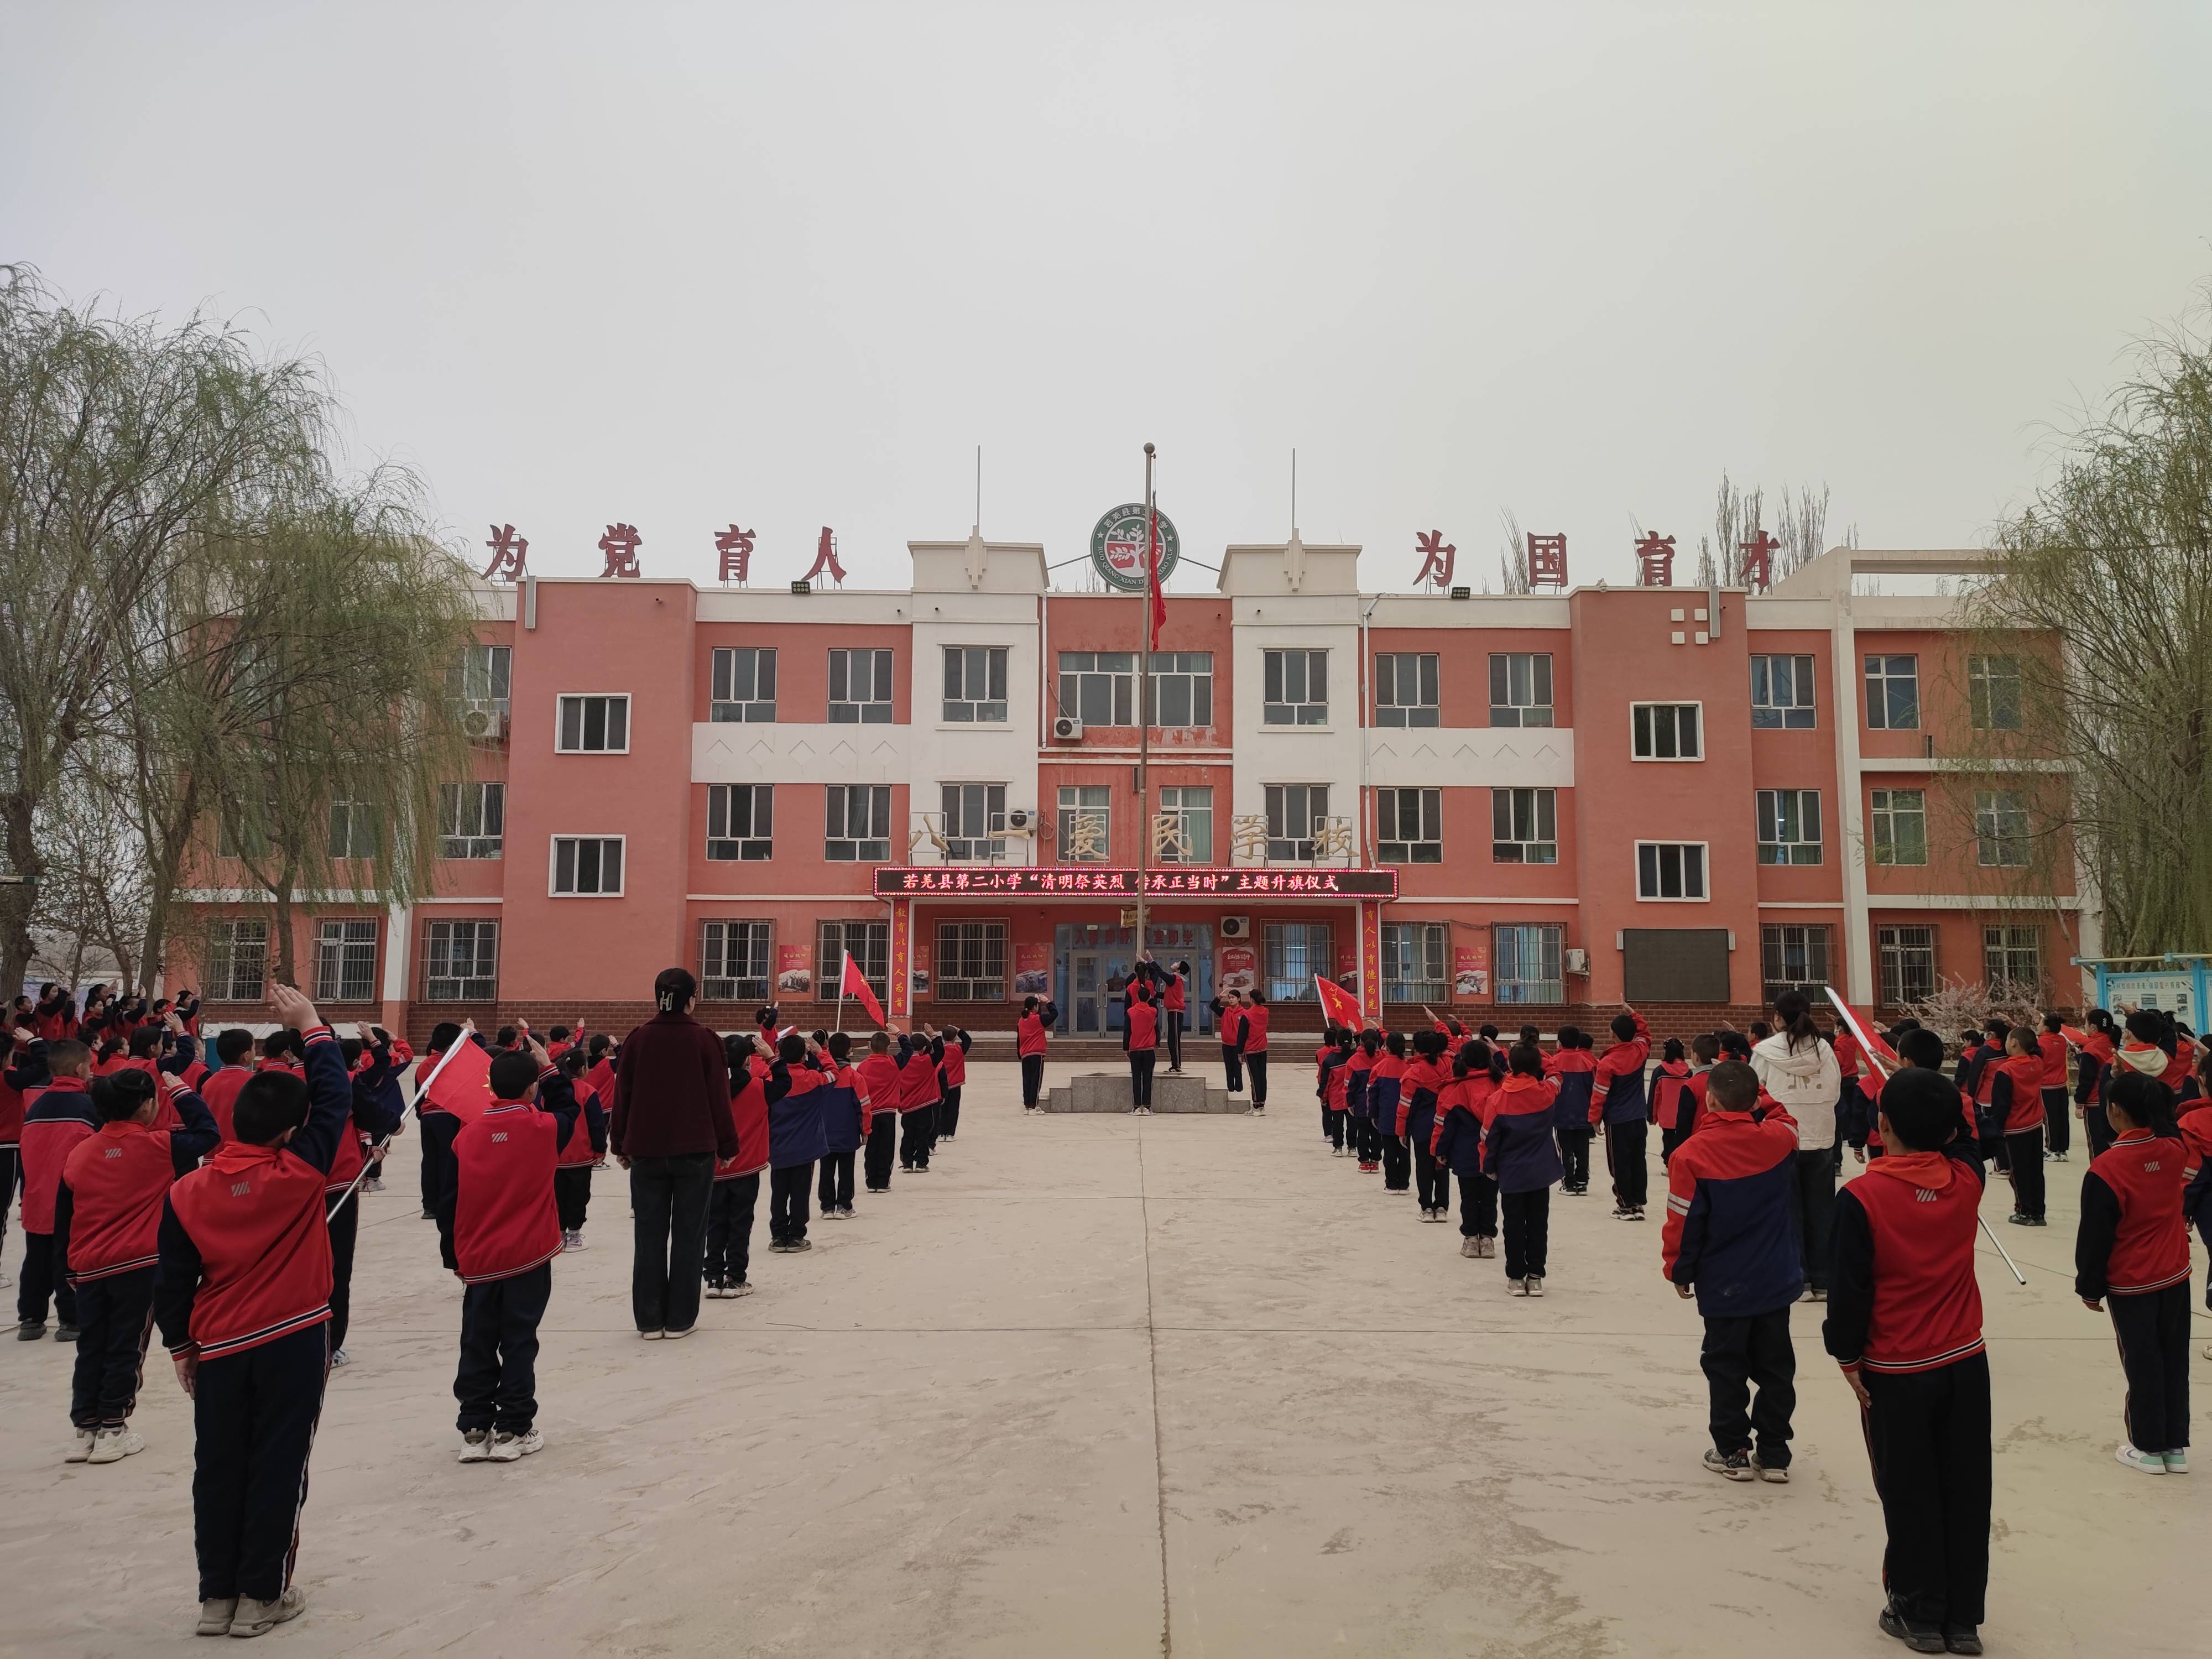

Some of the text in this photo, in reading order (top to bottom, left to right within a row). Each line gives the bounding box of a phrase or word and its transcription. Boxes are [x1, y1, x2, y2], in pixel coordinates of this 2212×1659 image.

[481, 523, 847, 581] 为党育人
[1413, 529, 1780, 588] 为国育才
